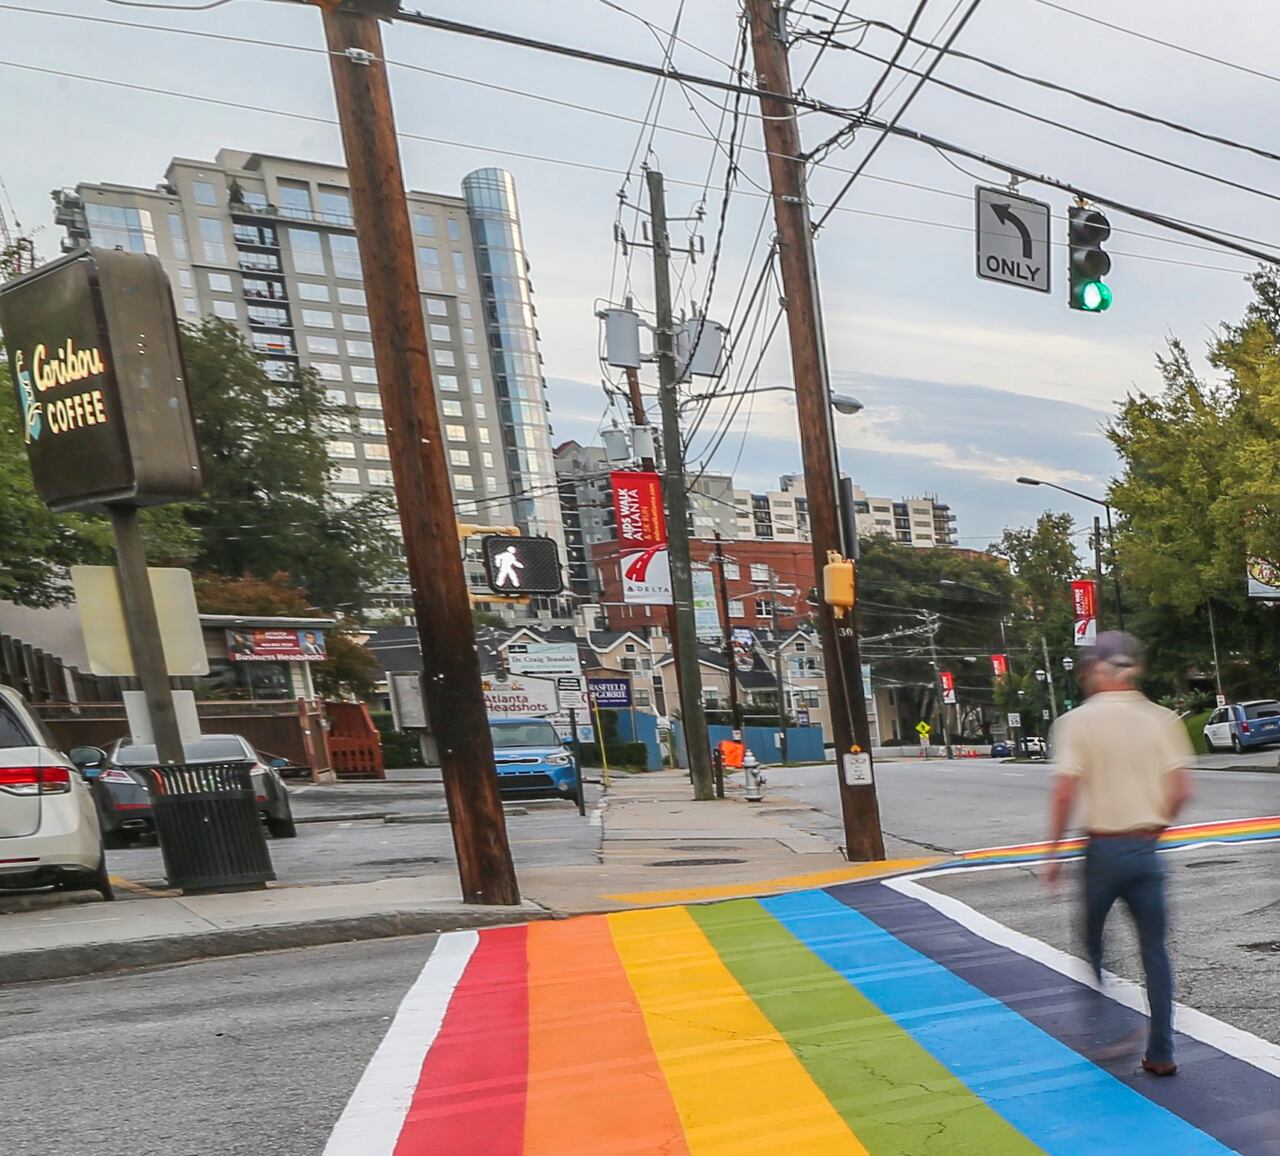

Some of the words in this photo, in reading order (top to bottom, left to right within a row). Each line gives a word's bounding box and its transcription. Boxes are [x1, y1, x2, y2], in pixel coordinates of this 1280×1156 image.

[986, 255, 1040, 282] ONLY
[33, 338, 104, 391] Caribou
[46, 390, 107, 434] COFFEE
[617, 488, 631, 516] WALK
[628, 488, 644, 541] ATLANTA
[620, 516, 634, 540] AIDS
[637, 585, 670, 593] DELTA
[838, 628, 853, 637] 30
[589, 683, 627, 691] RASFIELD
